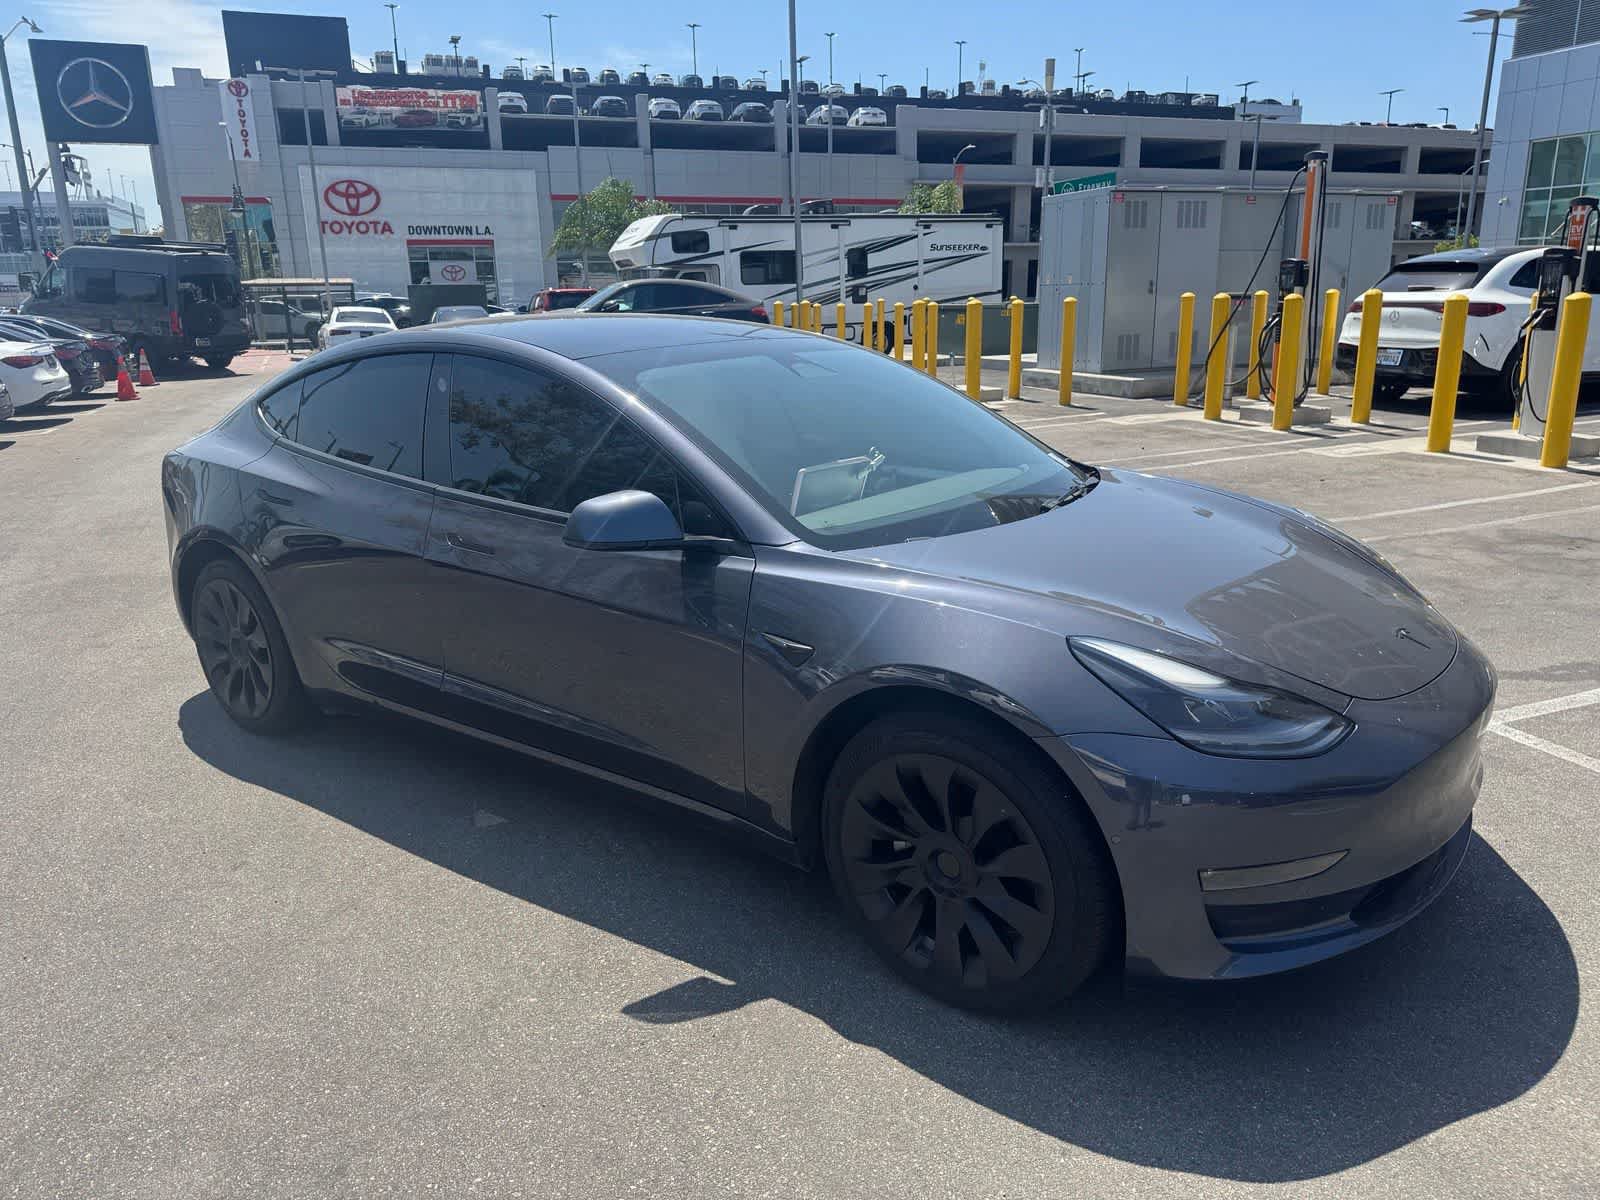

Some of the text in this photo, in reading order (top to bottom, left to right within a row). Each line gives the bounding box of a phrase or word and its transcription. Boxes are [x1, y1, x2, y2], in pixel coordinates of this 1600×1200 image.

[236, 99, 252, 158] TOYOTA
[320, 220, 394, 235] TOYOTA
[408, 225, 494, 236] DOWNTOWN L.A.
